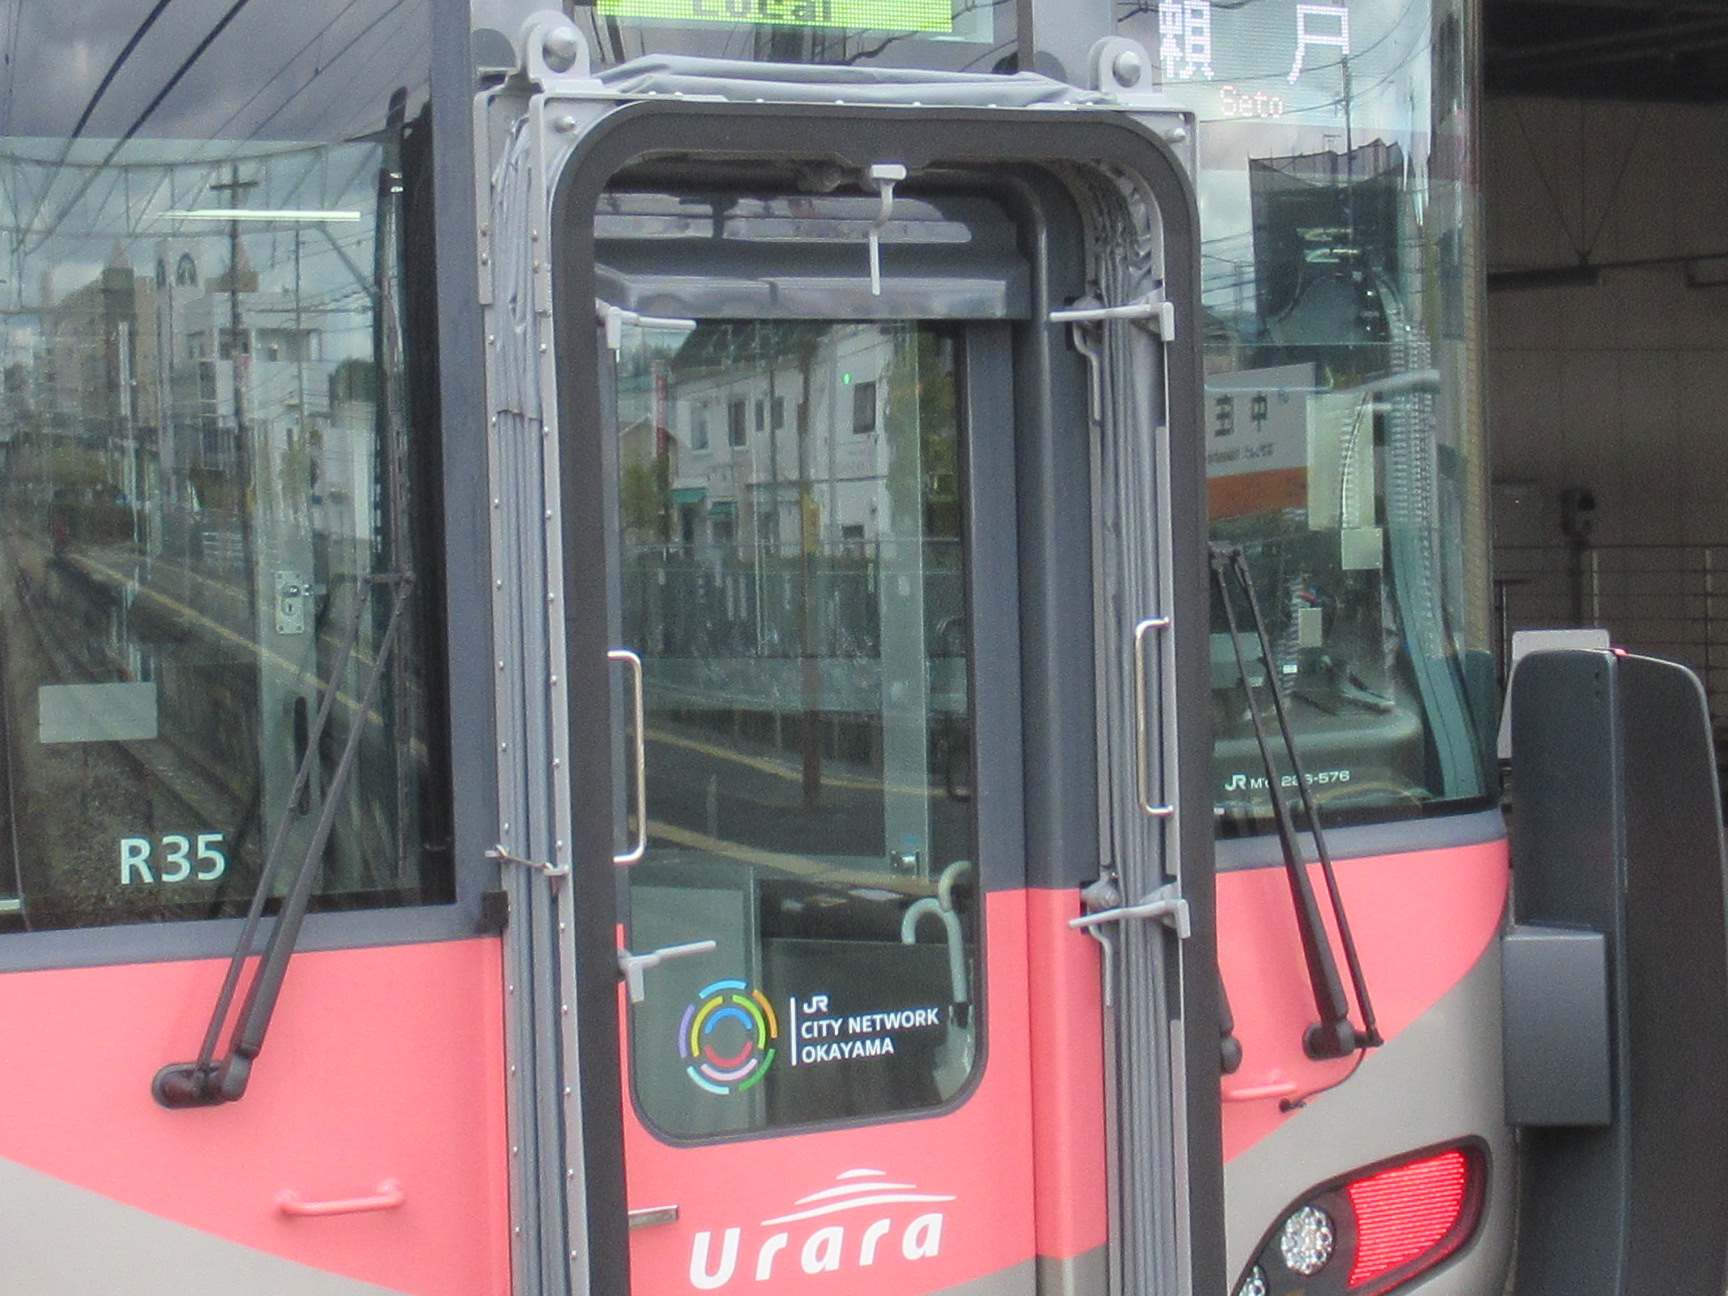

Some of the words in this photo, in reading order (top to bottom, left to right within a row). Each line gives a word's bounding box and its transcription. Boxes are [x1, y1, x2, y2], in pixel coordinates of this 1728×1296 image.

[1220, 84, 1284, 119] Seto
[1225, 773, 1247, 792] JR
[120, 833, 225, 885] R35
[802, 994, 830, 1014] JR
[801, 1017, 844, 1040] CITY
[847, 1007, 940, 1035] NETWORK
[801, 1037, 895, 1064] OKAYAMA
[688, 1211, 944, 1291] Urara
